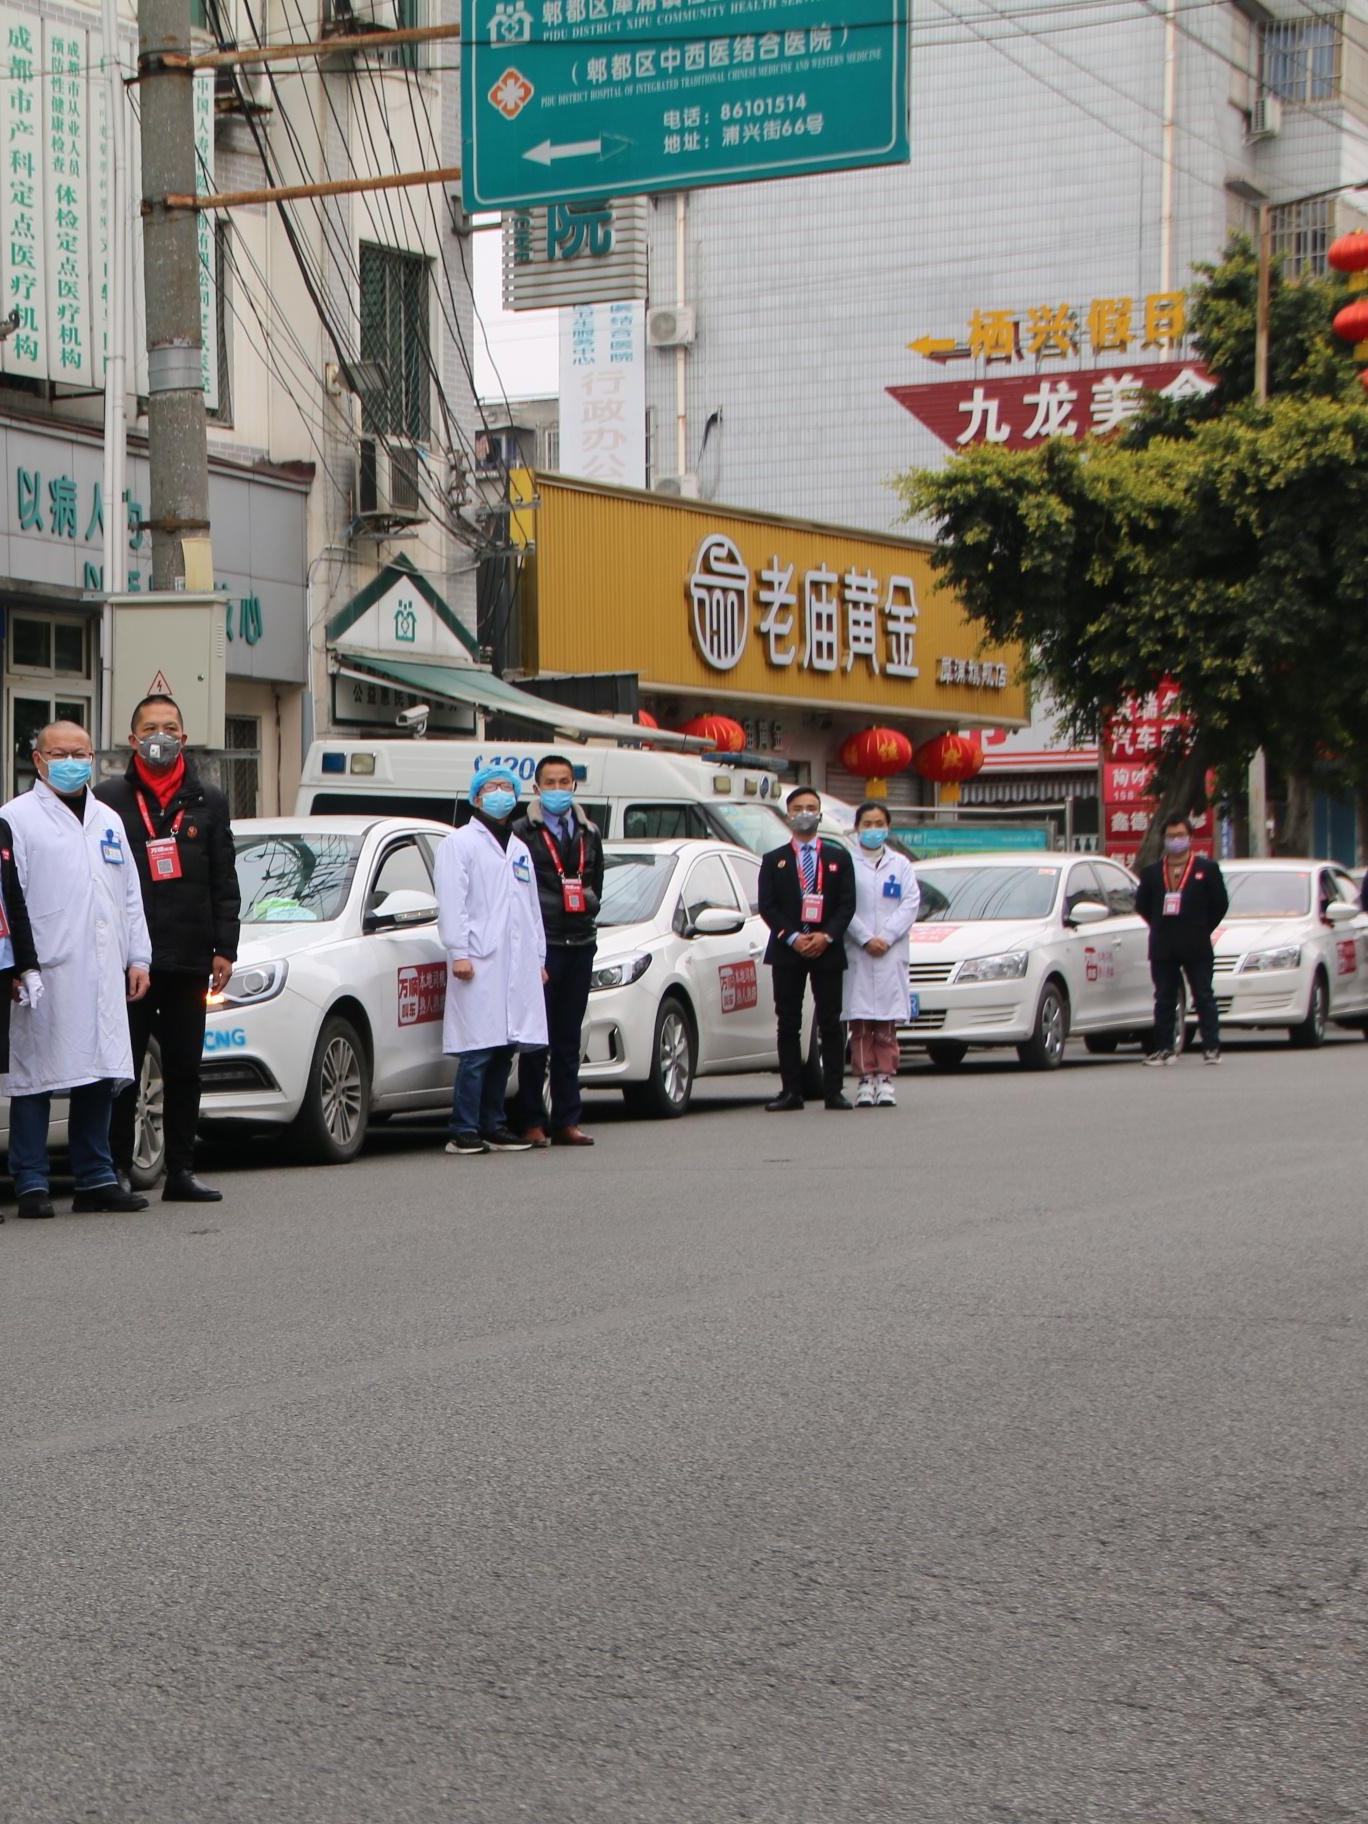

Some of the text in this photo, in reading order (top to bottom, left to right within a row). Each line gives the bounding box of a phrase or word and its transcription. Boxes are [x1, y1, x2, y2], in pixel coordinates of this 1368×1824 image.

[543, 30, 569, 42] PIDU
[572, 20, 622, 39] DISTRICT
[627, 16, 652, 30] XIPU
[657, 6, 726, 26] COMMUNITY
[558, 90, 589, 106] DISTRICT
[590, 86, 623, 102] HOSPITAL
[635, 78, 679, 96] INTEGRATED
[720, 92, 808, 121] 86101514
[721, 112, 825, 148] 浦兴街66号
[758, 554, 920, 678] 老庙黄金
[204, 1027, 248, 1051] CNG
